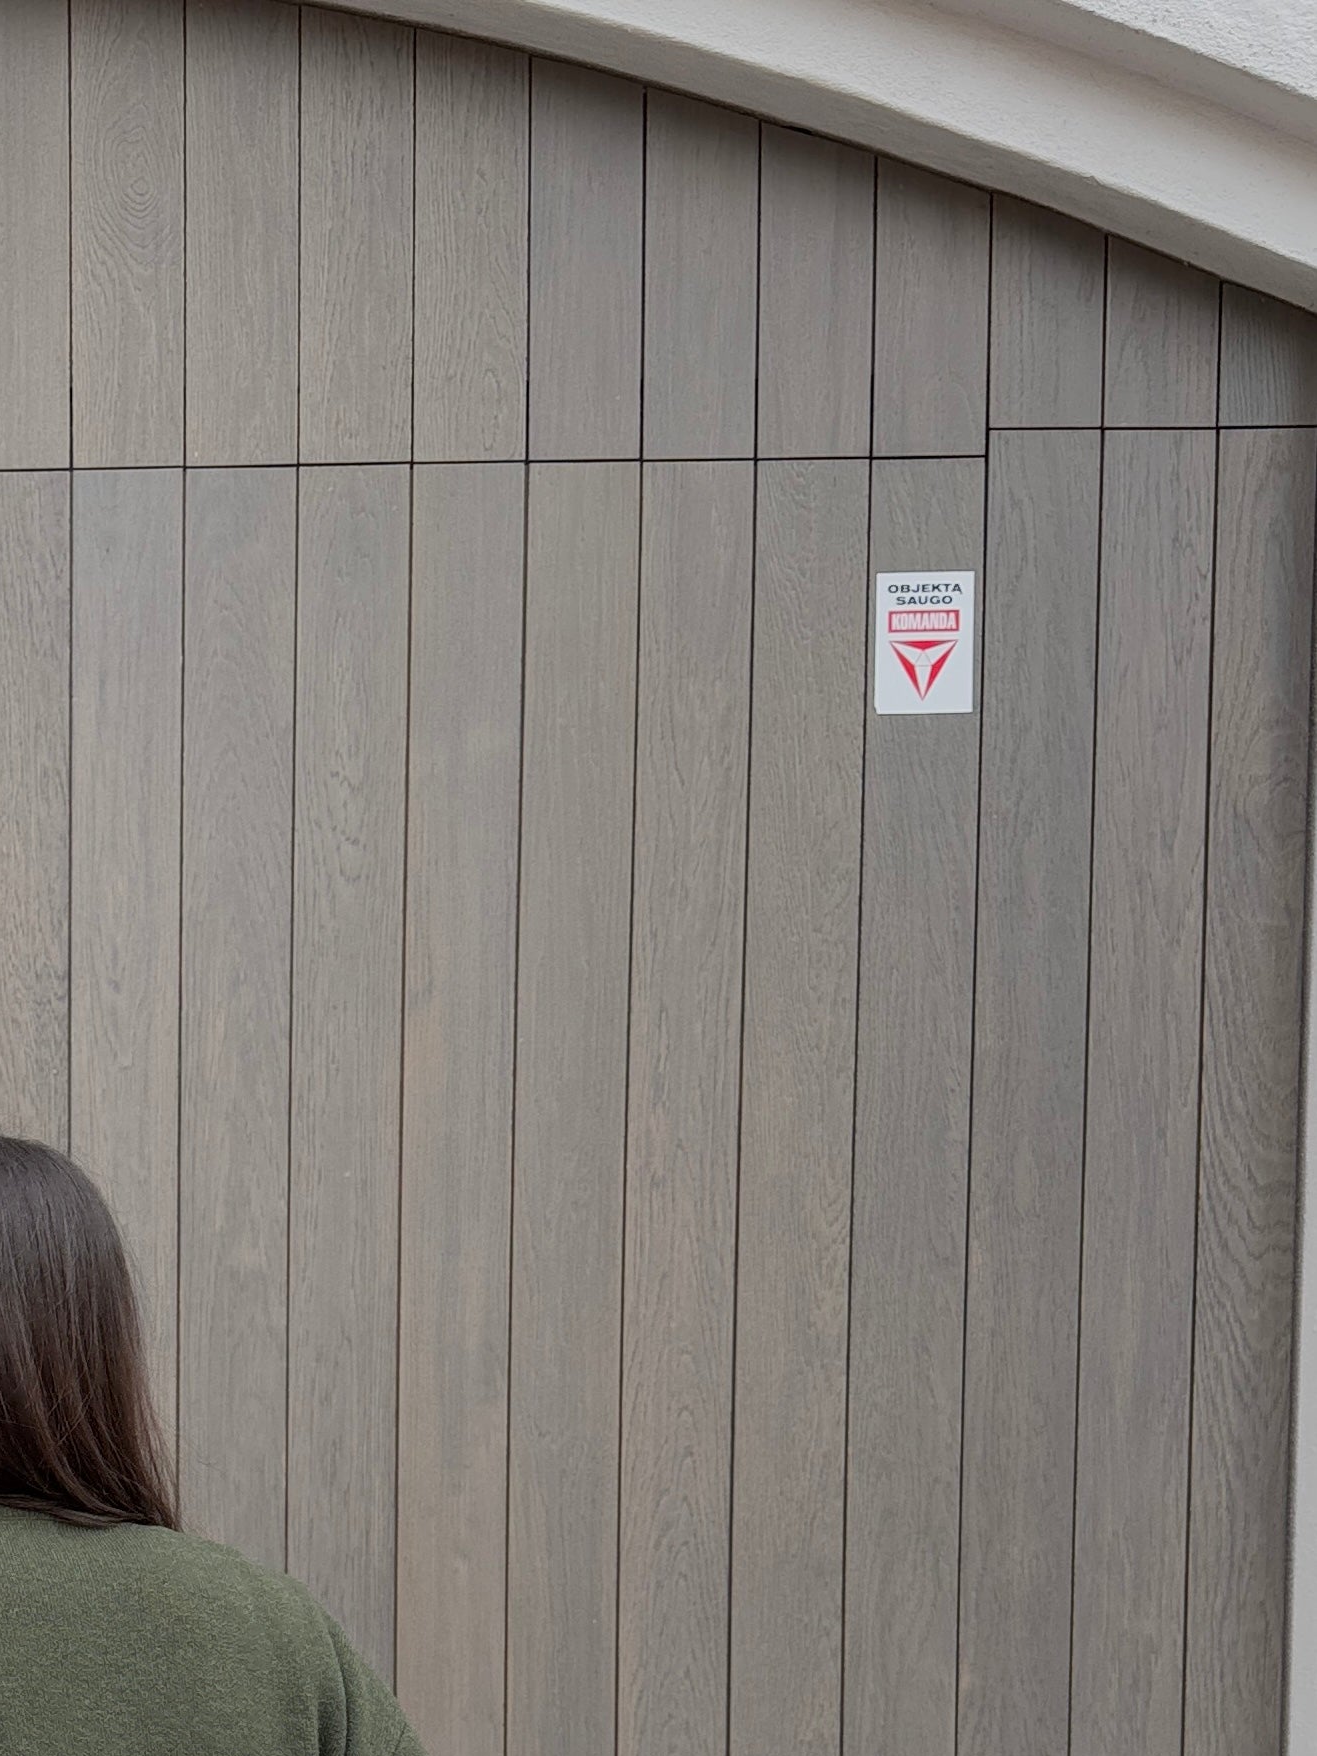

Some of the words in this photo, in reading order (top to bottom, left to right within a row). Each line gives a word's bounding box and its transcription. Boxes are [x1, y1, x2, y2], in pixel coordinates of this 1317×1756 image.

[887, 583, 963, 594] OBJEKTĄ
[895, 595, 953, 606] SAUGO
[891, 611, 957, 631] KOMANDA
